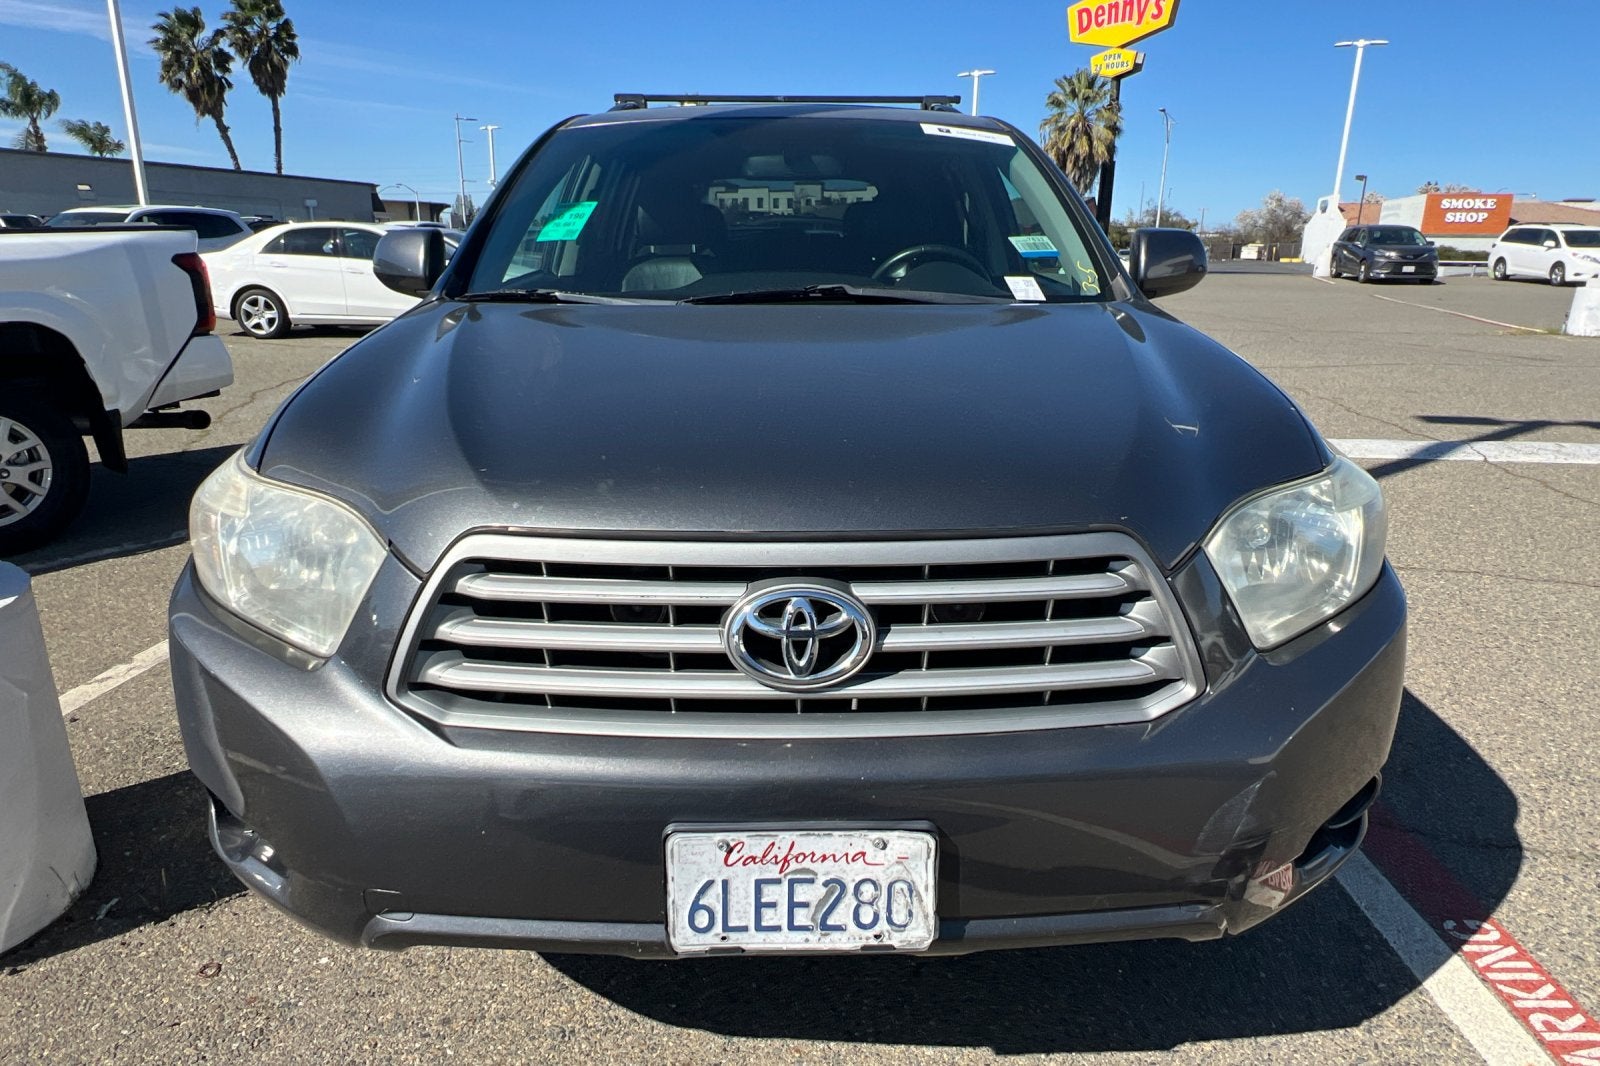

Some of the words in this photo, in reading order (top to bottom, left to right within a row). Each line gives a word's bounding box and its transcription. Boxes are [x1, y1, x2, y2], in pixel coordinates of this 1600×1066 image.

[1077, 0, 1164, 36] Dennys
[1103, 53, 1122, 62] OPEN
[1105, 61, 1130, 70] HOURS
[1440, 198, 1497, 210] SMOKE
[1444, 211, 1489, 223] SHOP
[722, 840, 885, 875] California
[687, 877, 914, 934] 6LEE280
